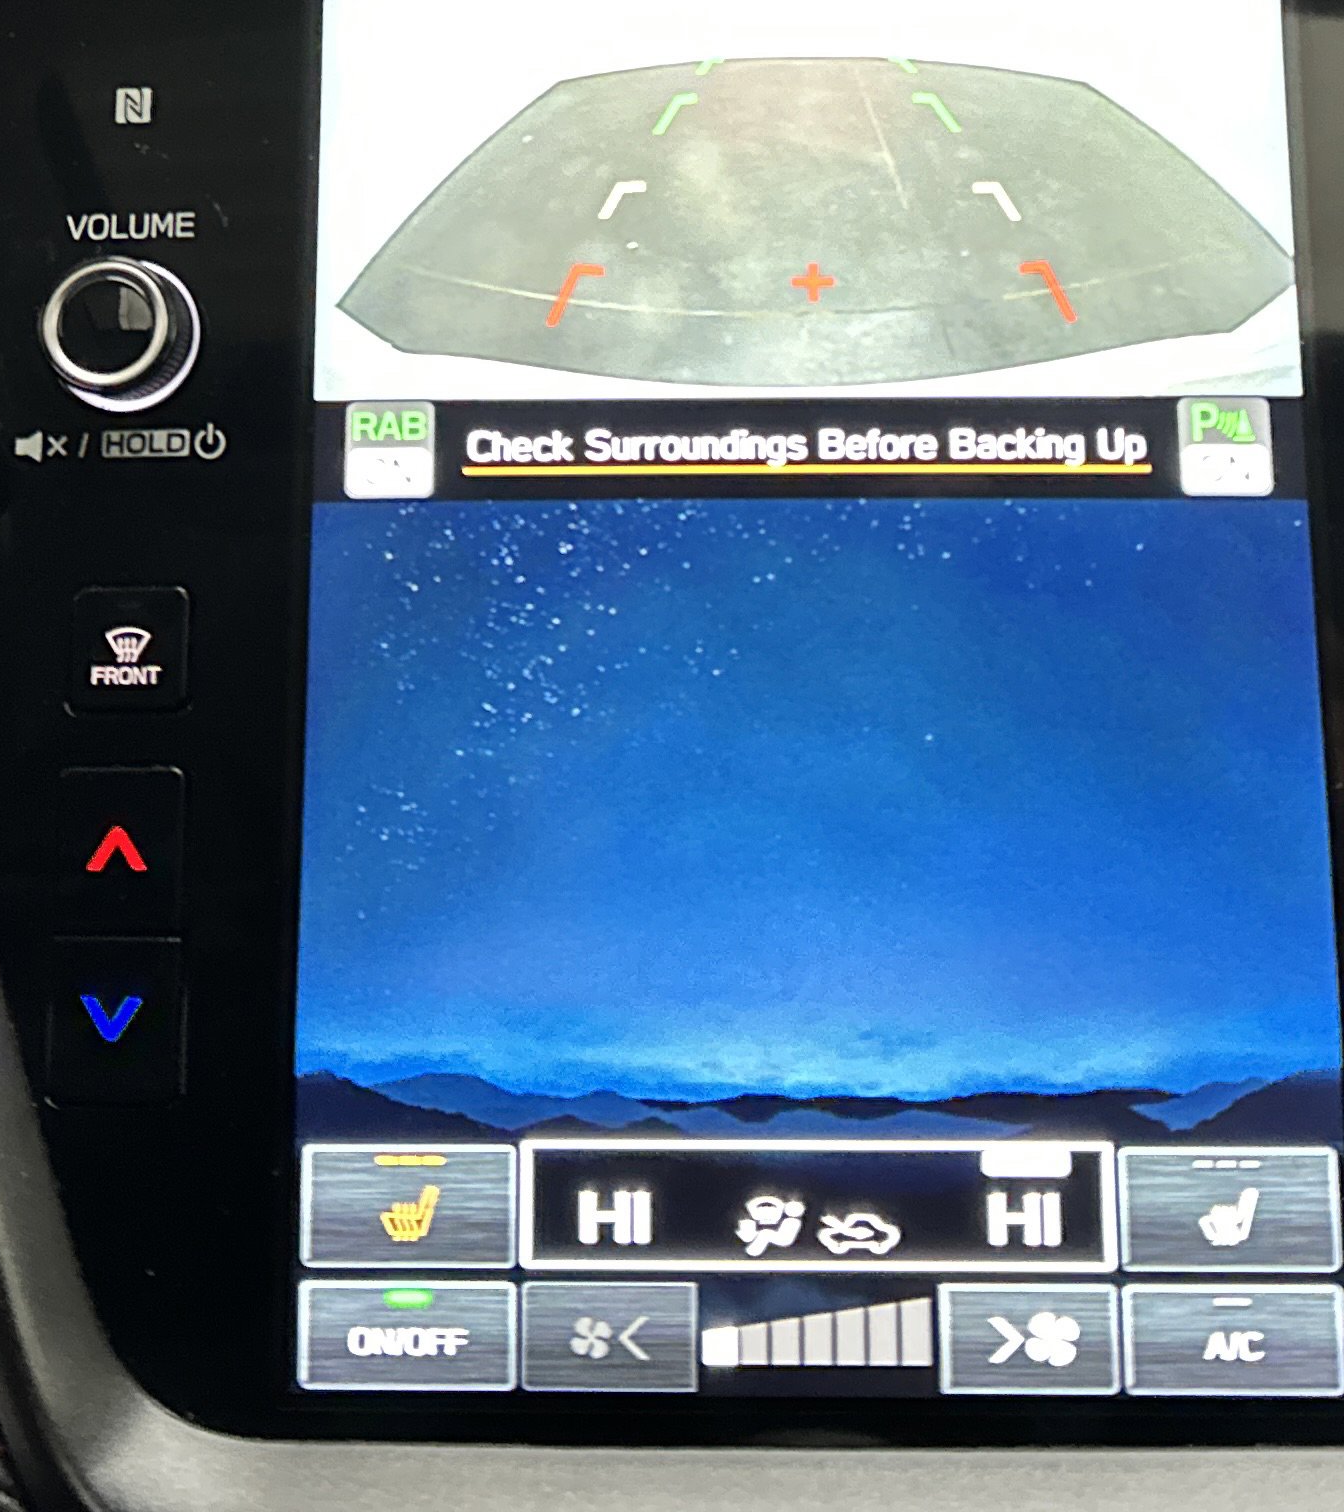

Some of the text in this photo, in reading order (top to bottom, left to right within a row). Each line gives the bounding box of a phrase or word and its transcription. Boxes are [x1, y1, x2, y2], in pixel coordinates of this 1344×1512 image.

[66, 211, 196, 240] VOLUME
[351, 410, 428, 442] RAB
[101, 431, 190, 457] HOLD
[466, 427, 1148, 467] Check Surroundings Before Backing Up
[89, 665, 163, 686] FRONT
[578, 1190, 652, 1245] HI
[987, 1191, 1062, 1247] HI
[346, 1326, 470, 1357] ON/OFF
[1202, 1330, 1267, 1362] A/C
